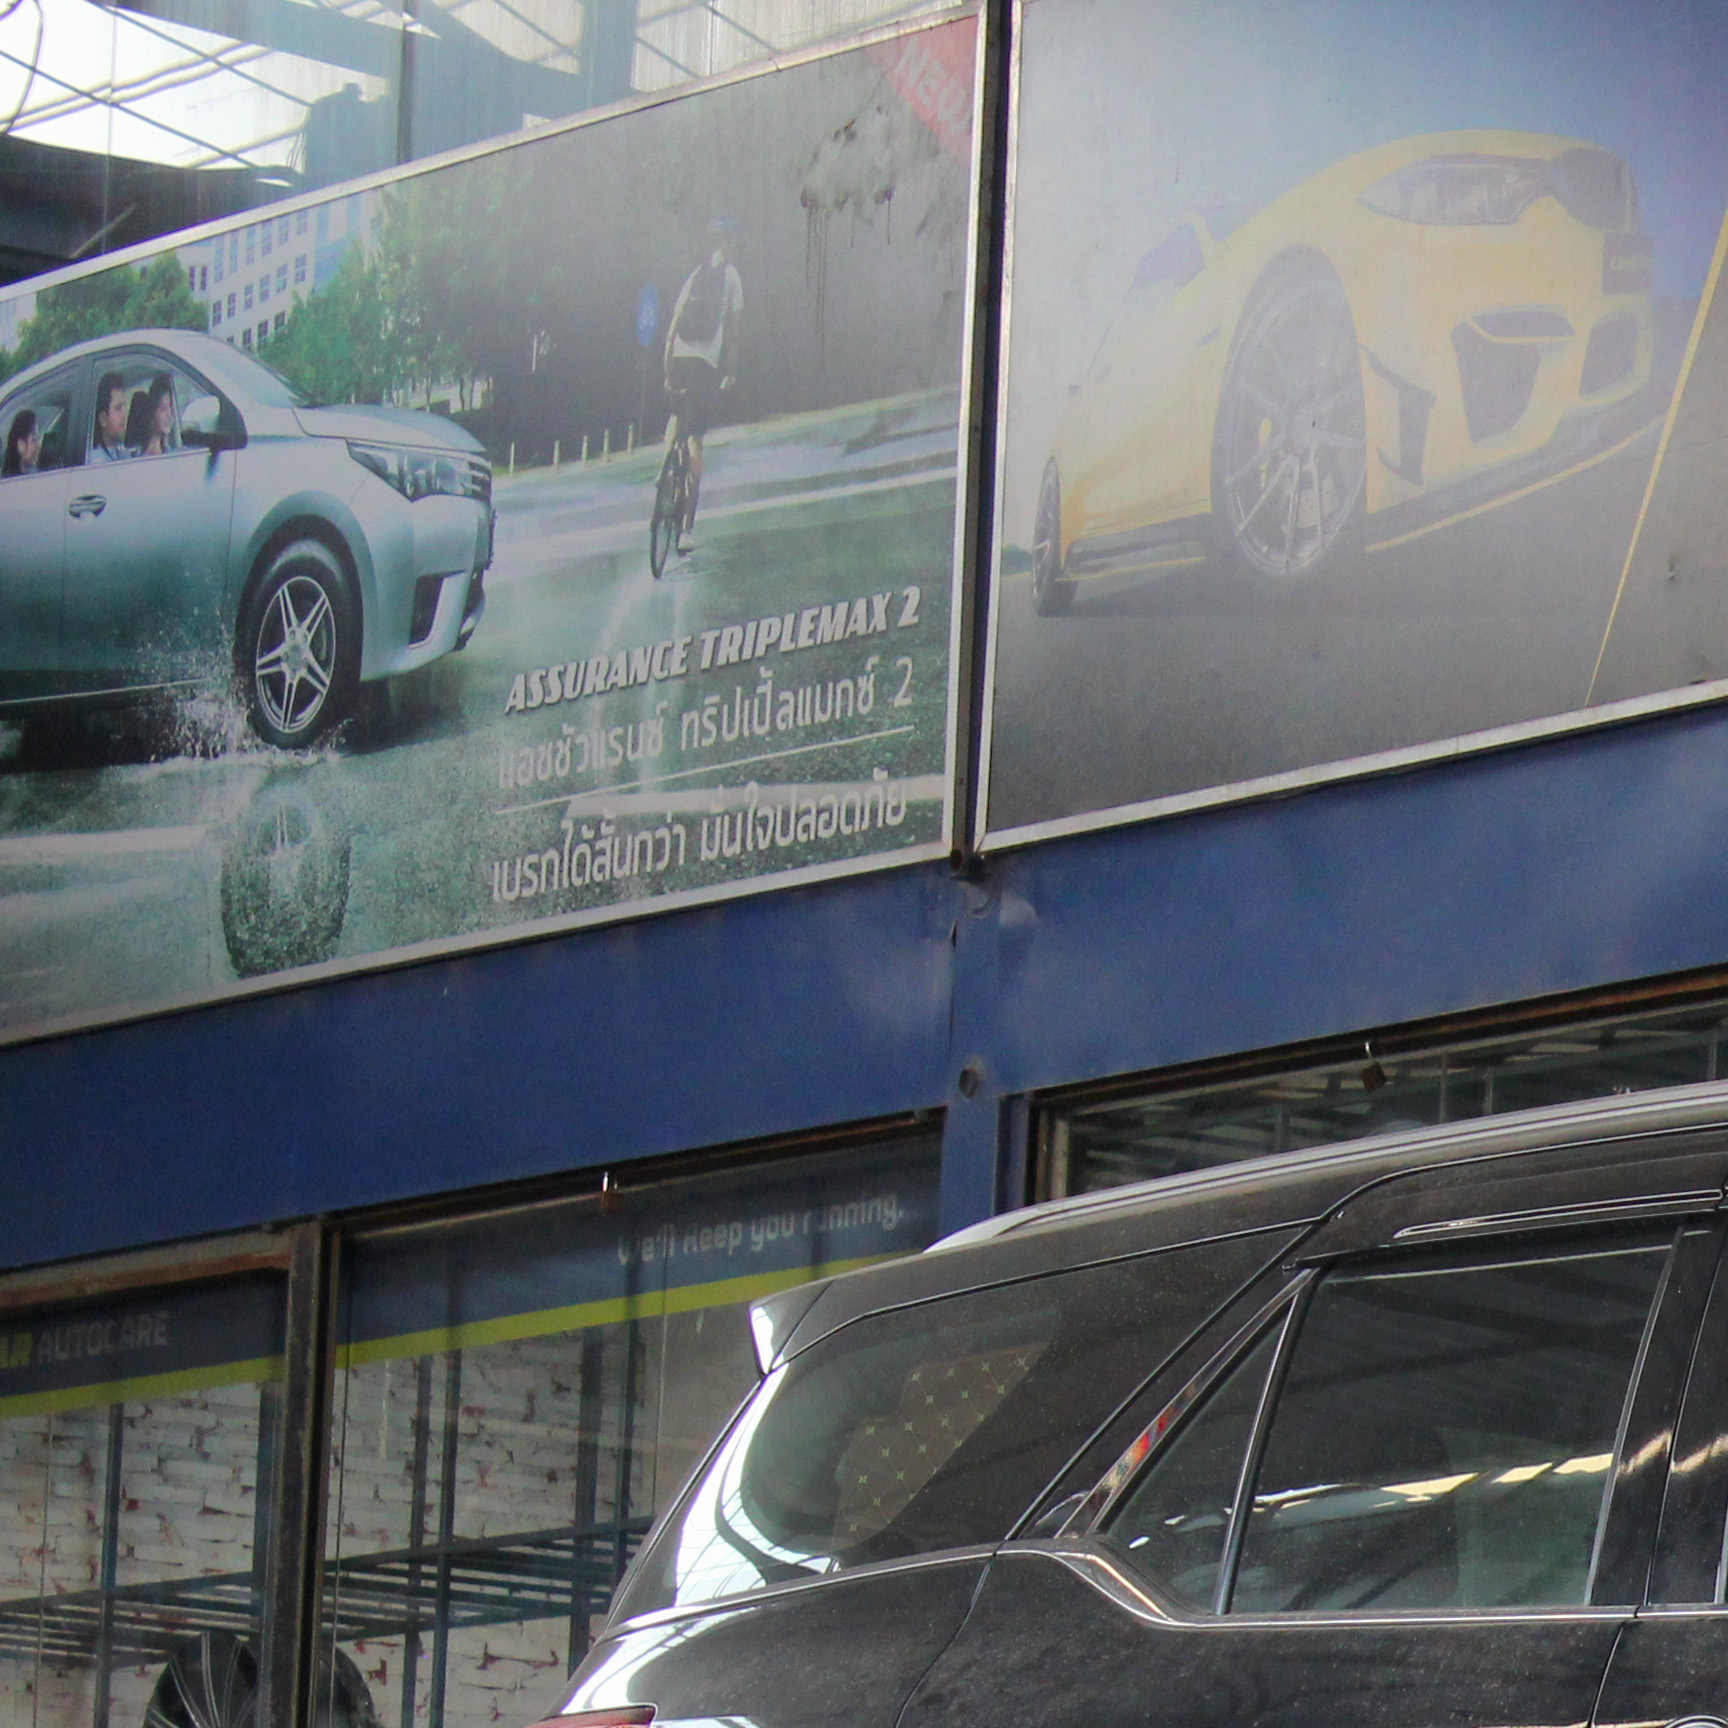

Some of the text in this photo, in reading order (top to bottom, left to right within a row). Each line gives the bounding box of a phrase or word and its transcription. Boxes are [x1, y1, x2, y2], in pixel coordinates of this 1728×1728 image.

[504, 584, 921, 716] ASSURANCE TRIPLEMAX 2
[893, 656, 915, 708] 2
[493, 810, 687, 900] เบรกได้สั้นกว่า
[750, 1212, 795, 1251] you
[37, 1311, 169, 1363] AUTOCARE
